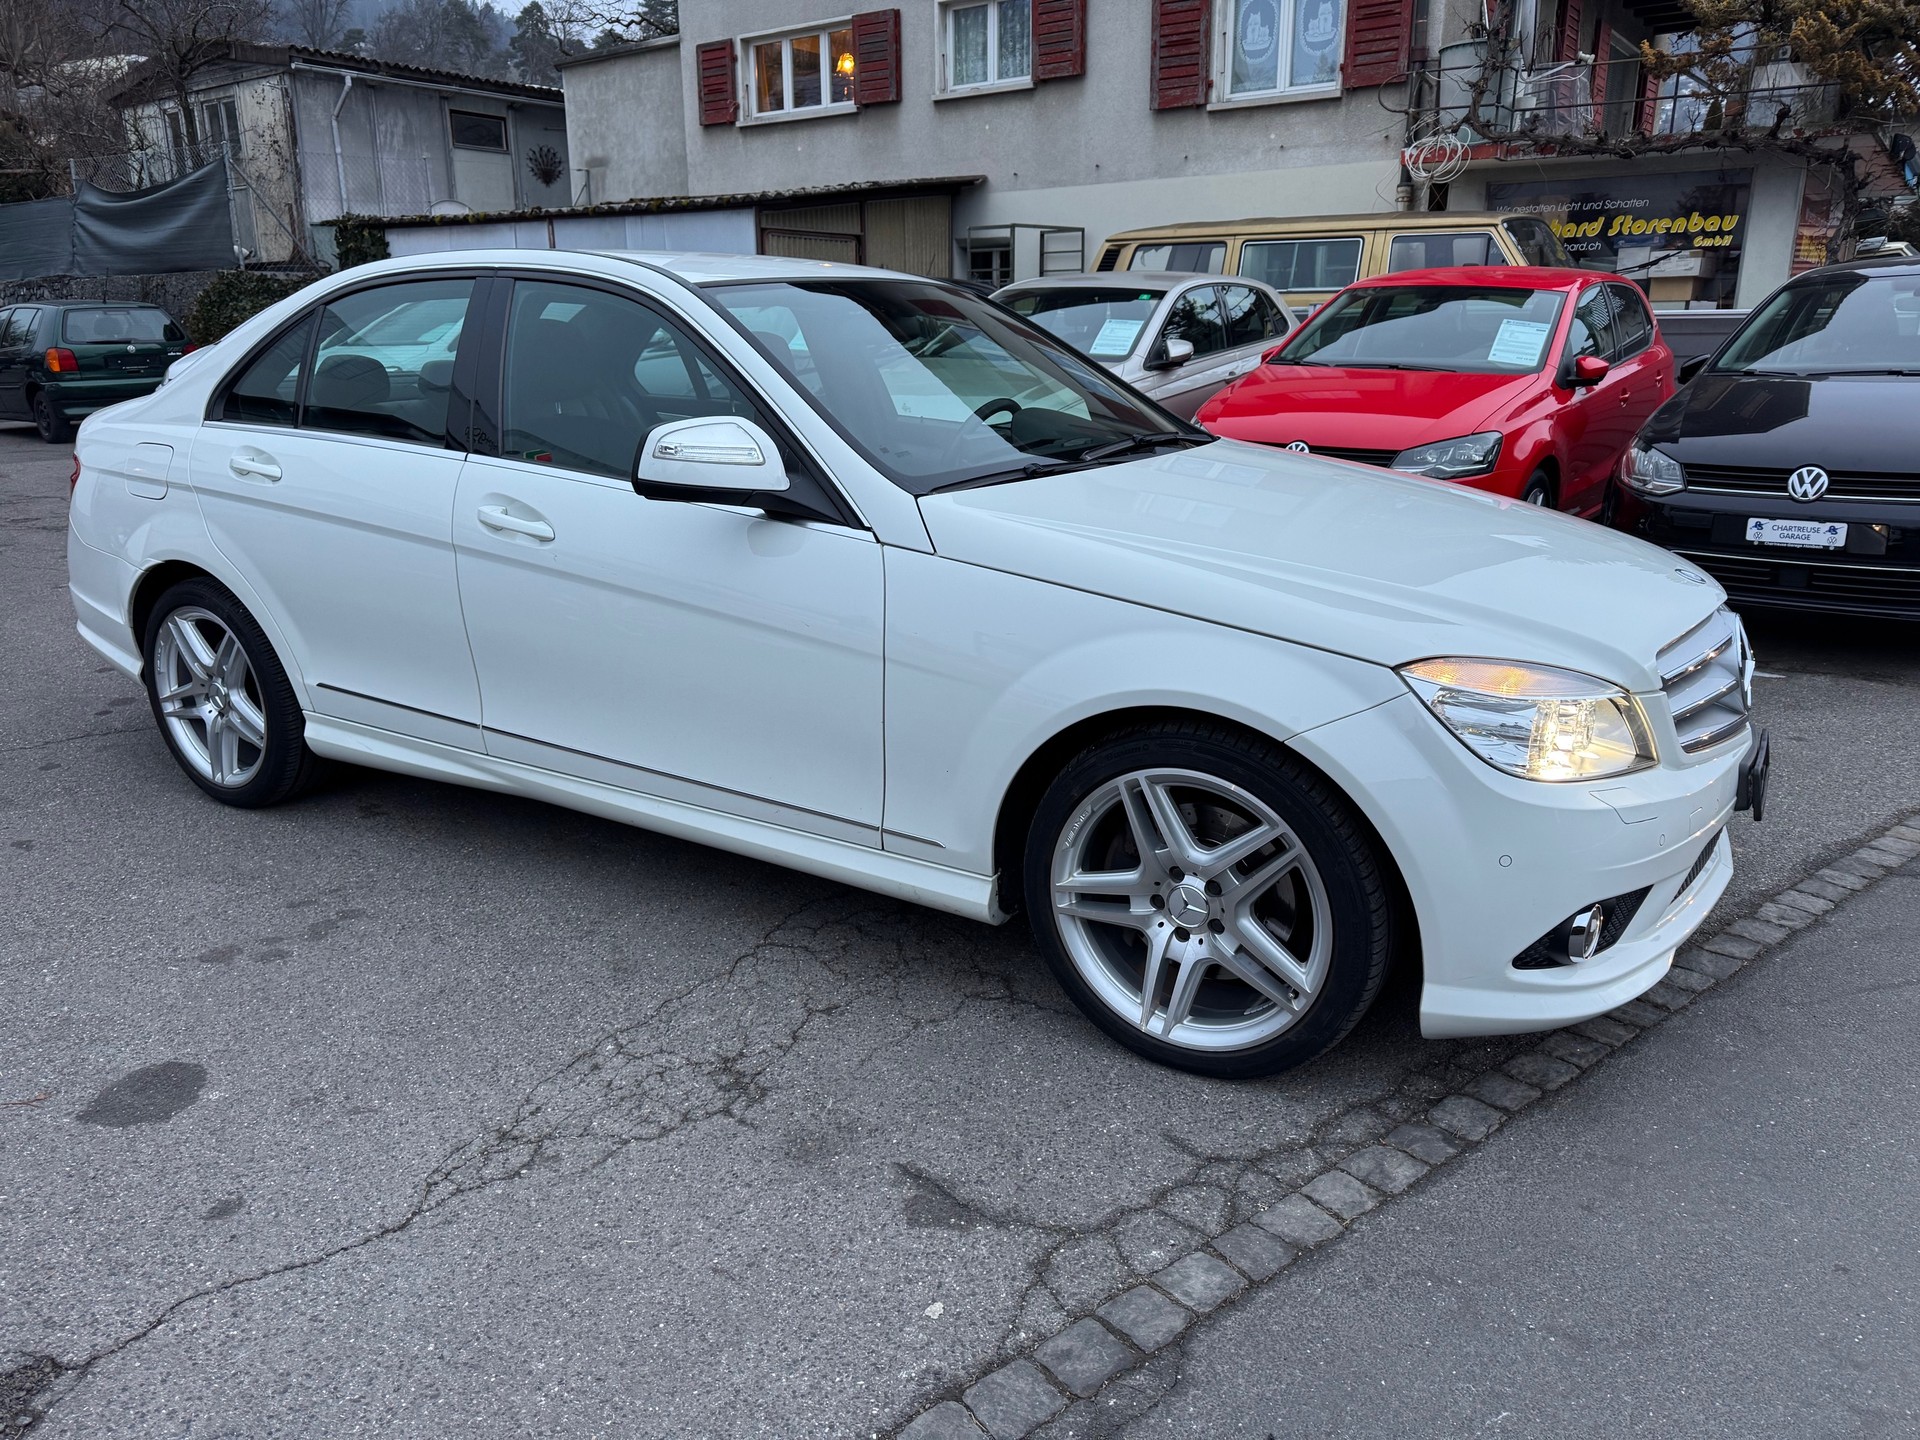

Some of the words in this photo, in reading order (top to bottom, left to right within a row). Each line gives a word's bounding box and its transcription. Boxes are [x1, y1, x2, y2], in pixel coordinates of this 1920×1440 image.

[1557, 201, 1581, 212] Licht
[1582, 200, 1602, 210] und
[1603, 198, 1650, 210] Schatten
[1607, 211, 1740, 237] Storenbau
[1693, 234, 1734, 247] GmbH
[1771, 524, 1821, 534] CHARTREUSE
[1779, 532, 1811, 541] GARAGE
